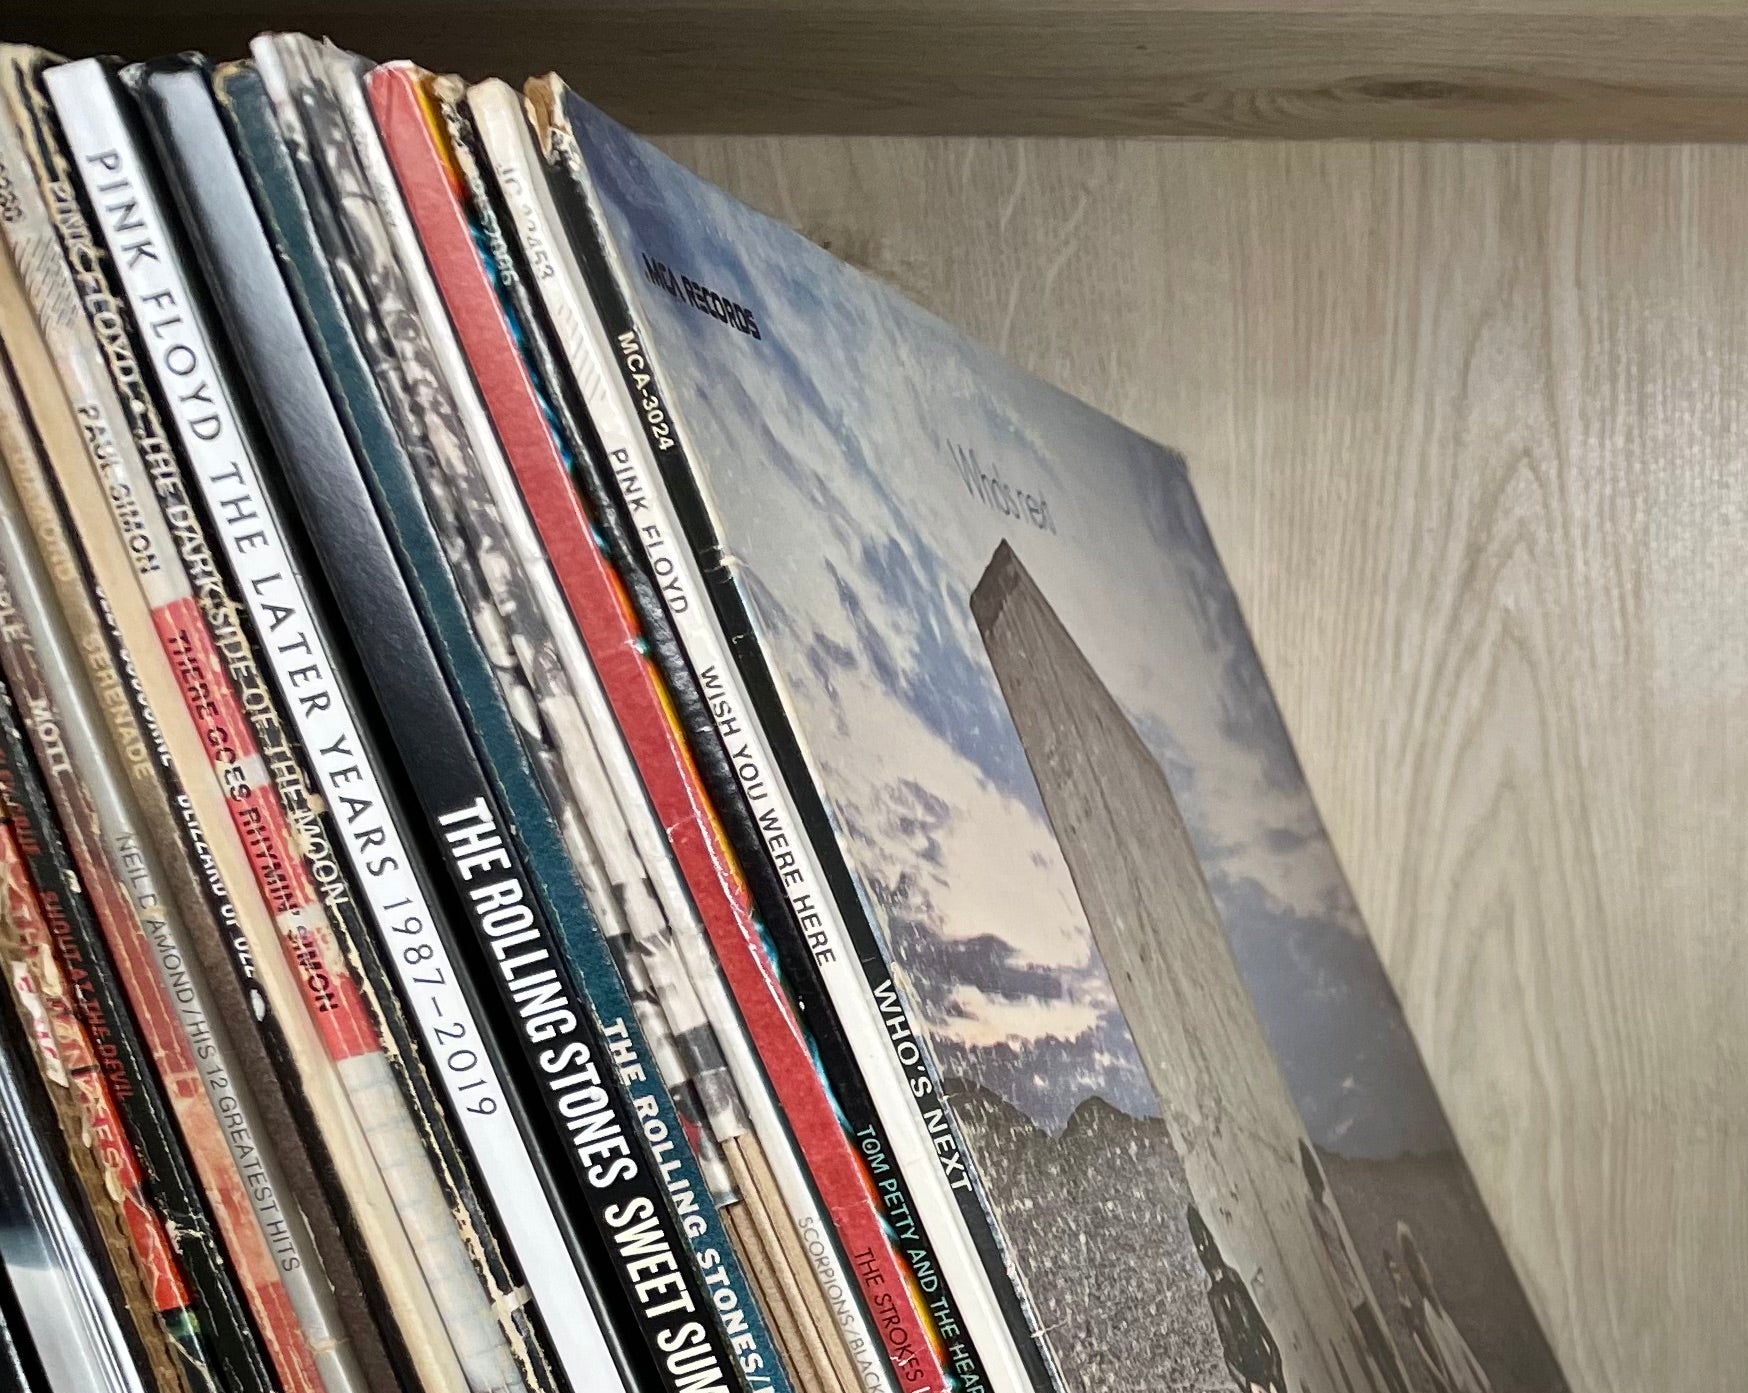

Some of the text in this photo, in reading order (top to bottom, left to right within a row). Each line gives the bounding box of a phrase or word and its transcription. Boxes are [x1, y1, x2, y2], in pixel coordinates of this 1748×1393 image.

[642, 253, 761, 340] MCA RECORDS
[617, 332, 674, 450] MCA-3024
[44, 178, 348, 908] PINK FLOYD THE DARK SIDE OF THE MOON
[86, 148, 159, 269] PINK
[140, 291, 222, 441] FLOYD
[205, 461, 270, 554] THE
[251, 572, 332, 718] LATER
[319, 736, 399, 879] YEARS
[29, 699, 73, 777] MOTT
[76, 402, 121, 474] PAUL
[105, 480, 162, 576] SIMON
[165, 628, 220, 720] THERE
[204, 724, 253, 803] GOES
[286, 924, 338, 1014] SIMON
[81, 630, 153, 780] SERENADE
[611, 448, 837, 967] PINK FLOYD WISH YOU WERE HERE
[436, 795, 512, 884] THE
[467, 874, 582, 1046] ROLLING
[97, 1042, 134, 1103] DEVIL
[116, 834, 301, 1273] NEIL 12 GREATEST HITS
[534, 1035, 642, 1193] STONES
[600, 1017, 646, 1087] THE
[631, 1094, 709, 1239] ROLLING
[871, 980, 973, 1193] WHO'S NEXT
[600, 1190, 698, 1328] SWEET
[853, 1124, 890, 1175] TOM
[875, 1176, 921, 1244] PETTY
[905, 1244, 941, 1294] AND
[927, 1296, 960, 1340] THE
[853, 1247, 886, 1288] THE
[869, 1291, 928, 1383] STROKES
